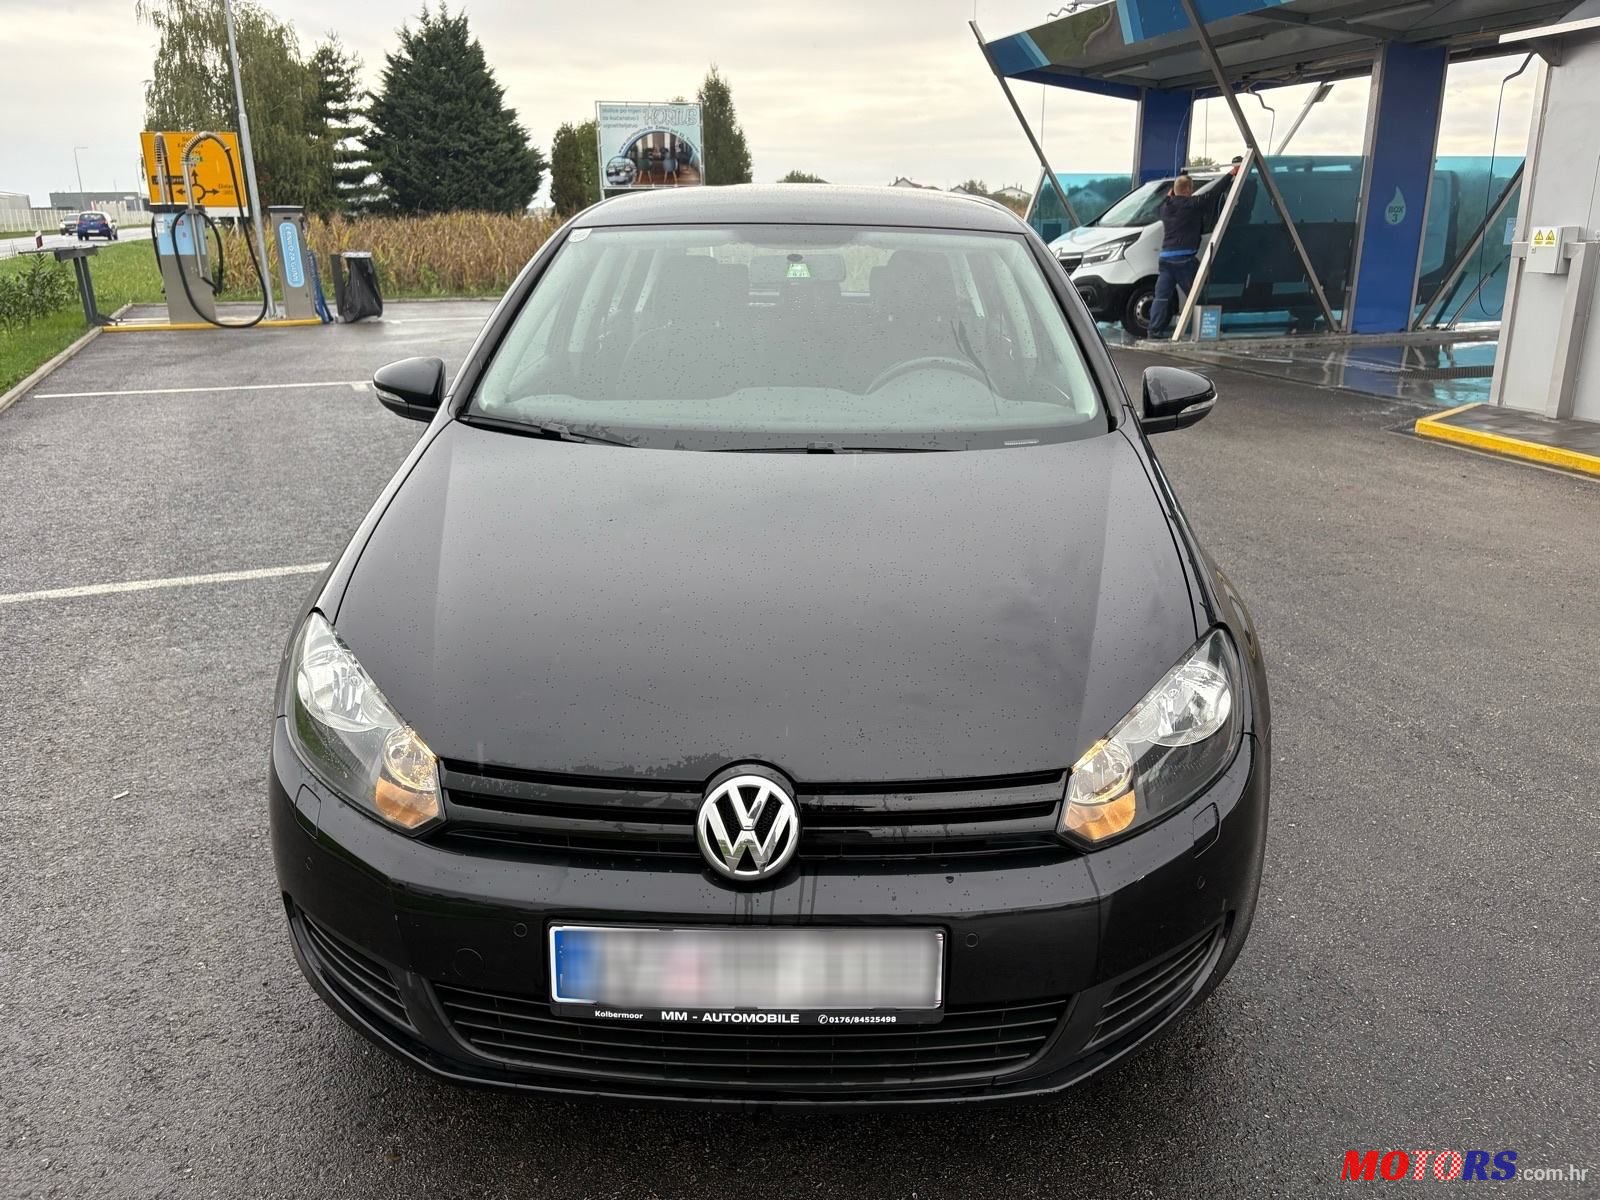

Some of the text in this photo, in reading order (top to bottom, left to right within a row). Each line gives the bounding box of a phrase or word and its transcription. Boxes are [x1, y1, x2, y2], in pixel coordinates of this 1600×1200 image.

[698, 775, 798, 879] VW
[595, 1010, 643, 1019] Kolbermoor
[661, 1011, 688, 1021] MM
[702, 1012, 800, 1024] AUTOMOBILE
[829, 1016, 897, 1024] 0176/84525498
